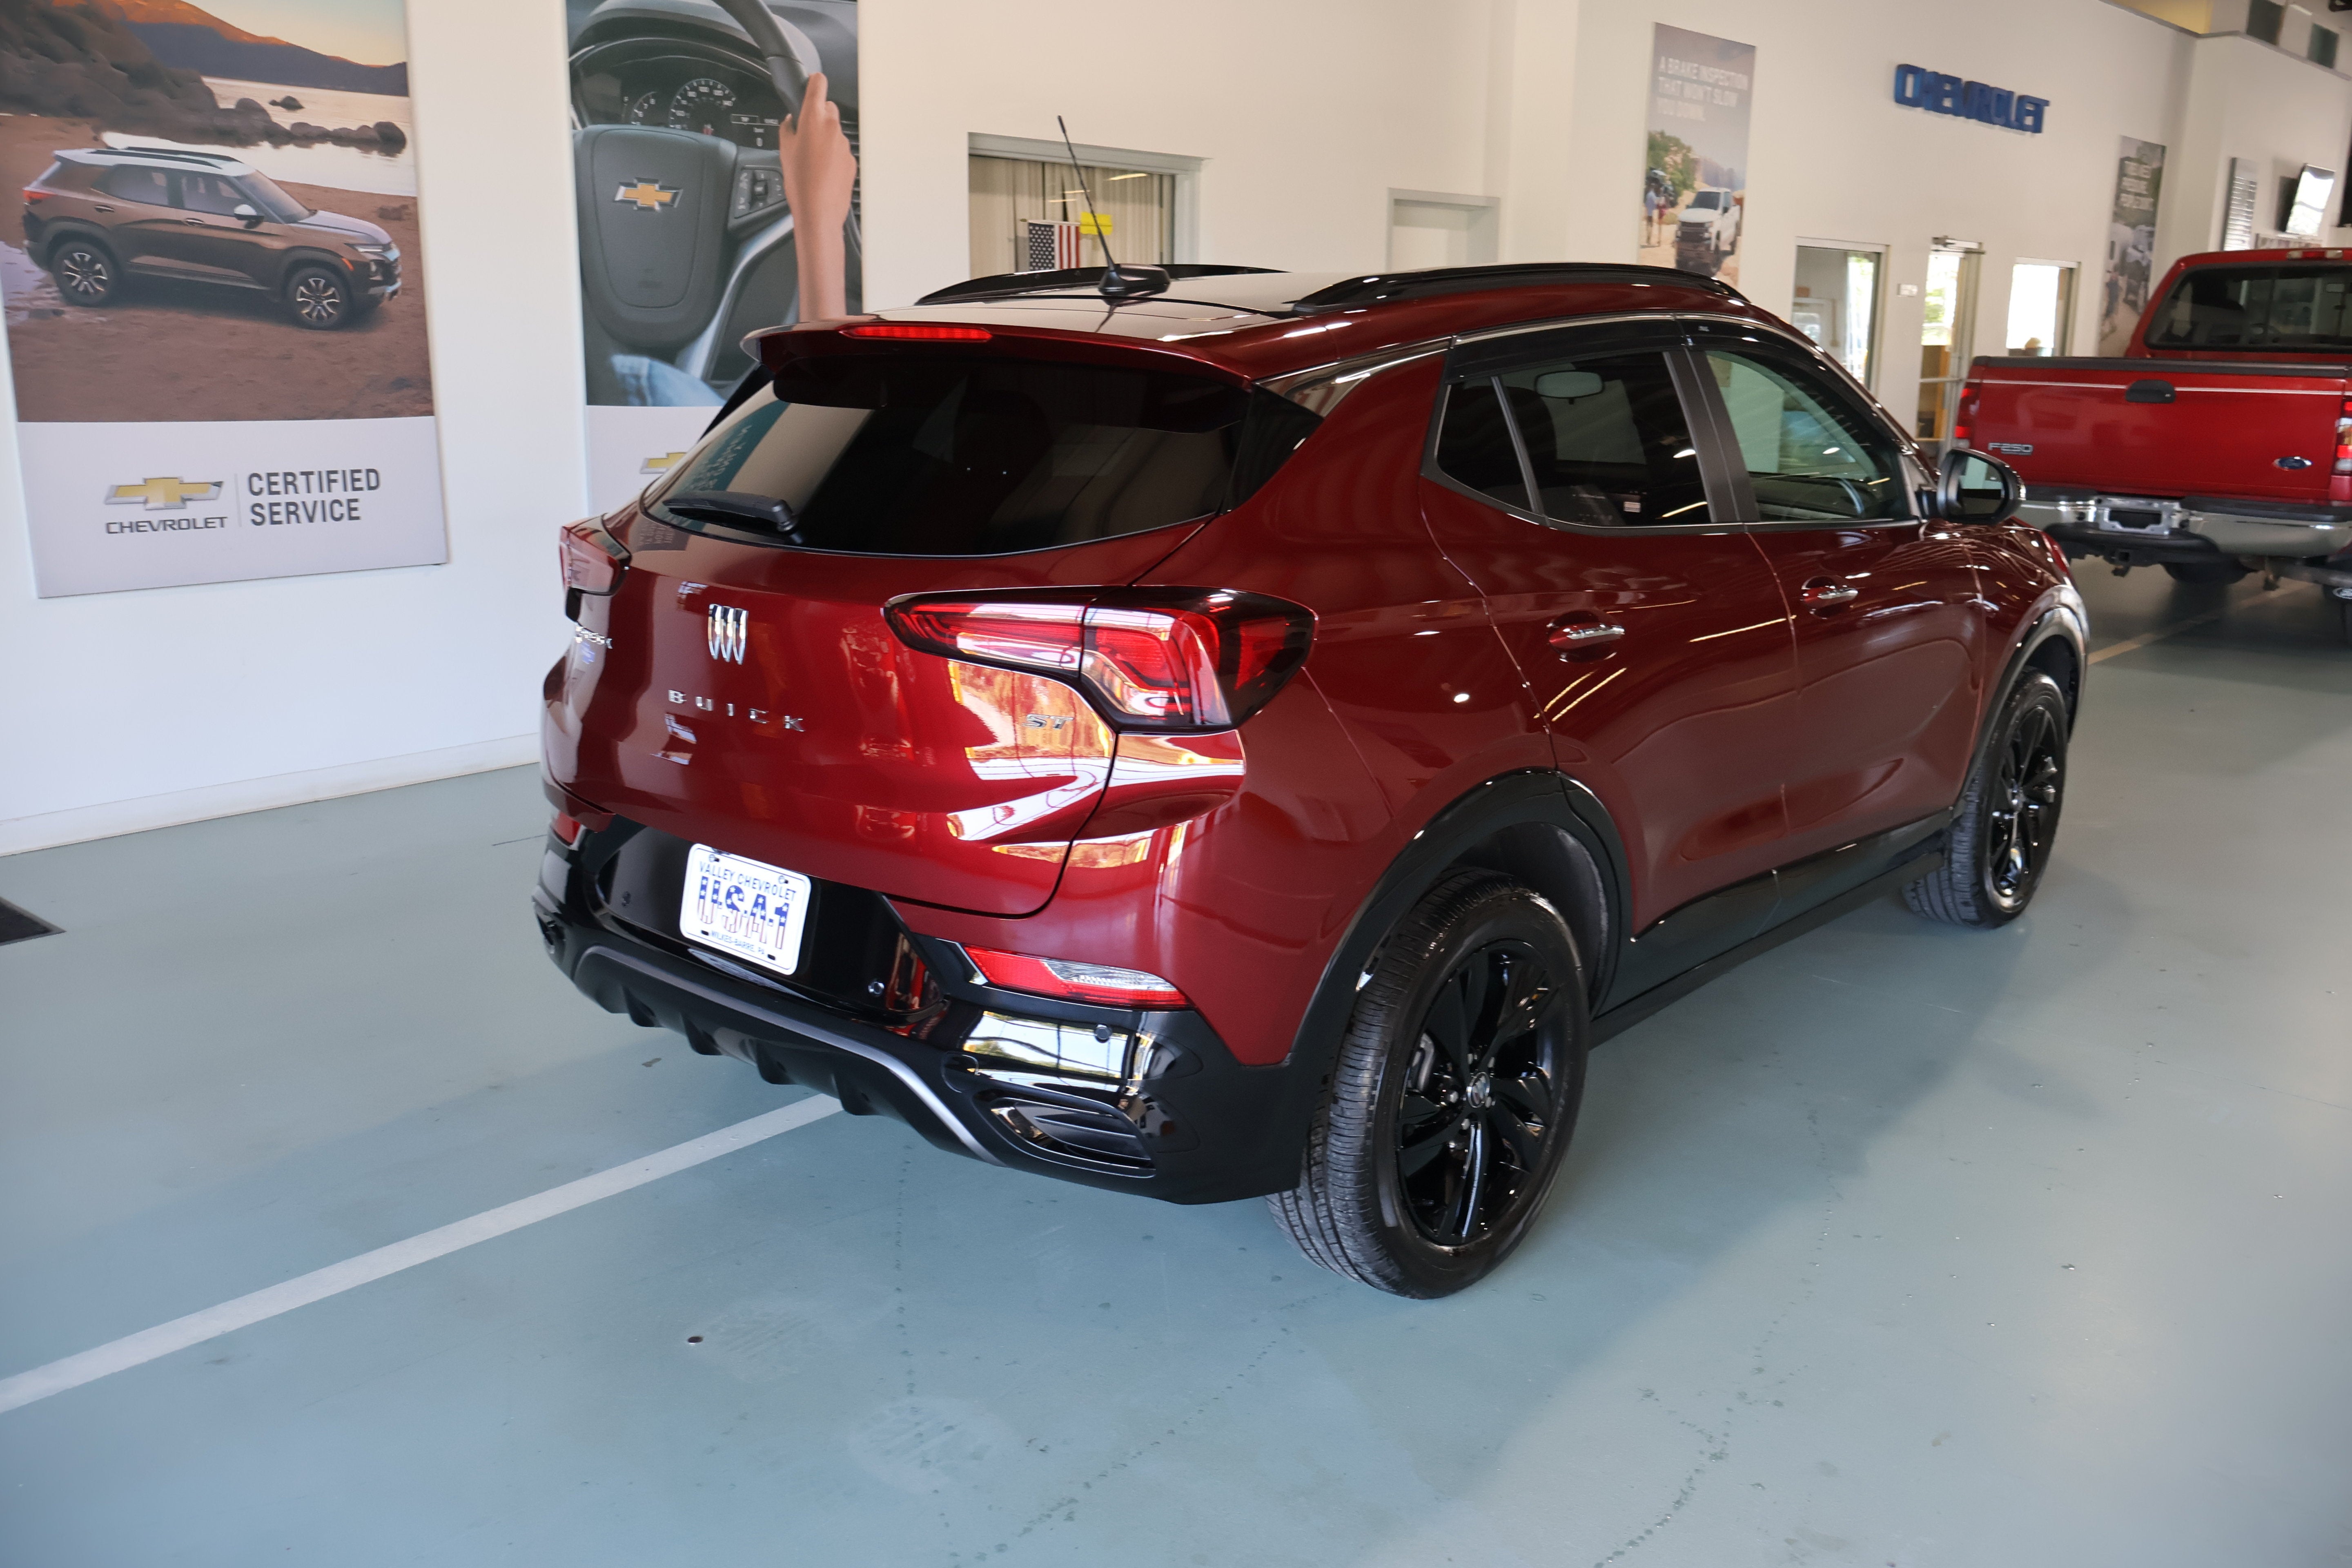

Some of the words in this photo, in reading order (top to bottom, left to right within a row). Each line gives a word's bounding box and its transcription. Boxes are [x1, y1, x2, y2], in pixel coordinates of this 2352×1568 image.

[248, 468, 380, 496] CERTIFIED
[105, 516, 228, 535] CHEVROLET
[250, 498, 361, 527] SERVICE
[668, 689, 805, 732] BUICK
[1022, 714, 1074, 730] ST
[699, 861, 736, 882] VALLEY
[737, 873, 797, 902] CHEVROLET
